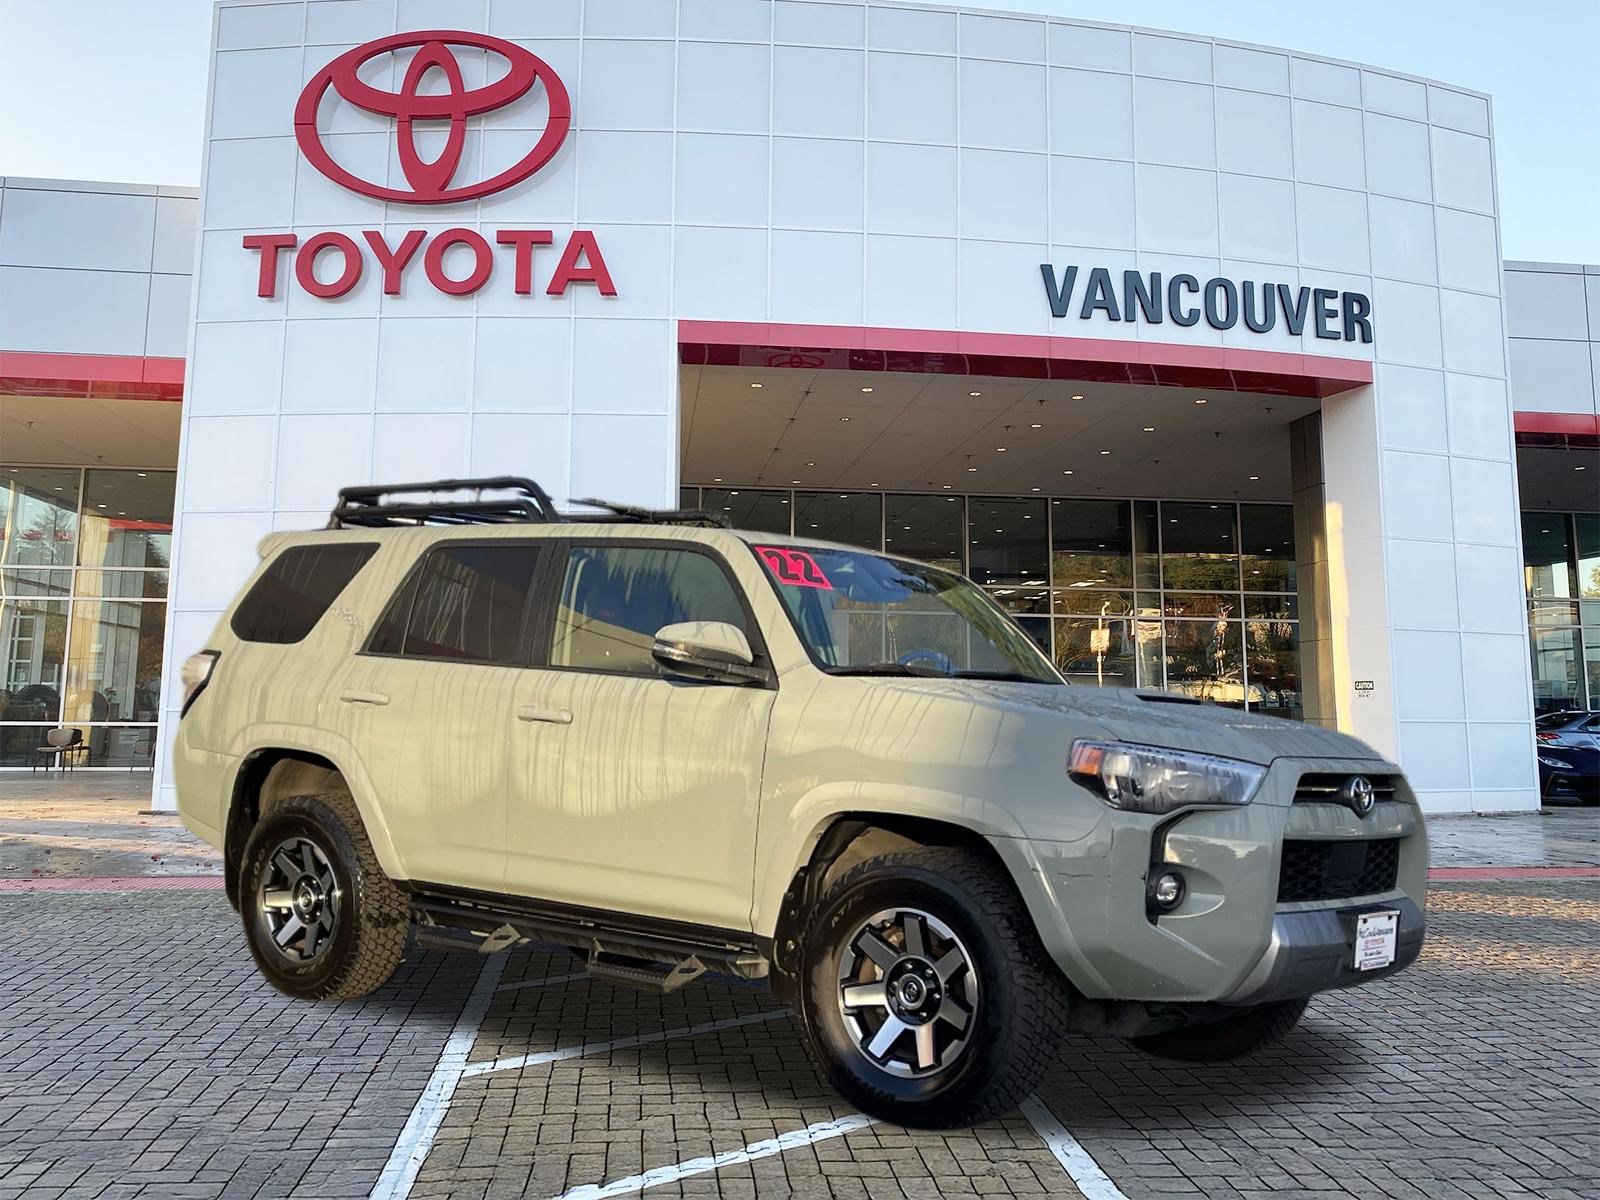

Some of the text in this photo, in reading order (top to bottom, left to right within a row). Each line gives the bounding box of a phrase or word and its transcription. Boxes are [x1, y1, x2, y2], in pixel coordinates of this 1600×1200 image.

[243, 228, 617, 299] TOYOTA
[1040, 264, 1373, 343] VANCOUVER
[762, 550, 825, 584] 22
